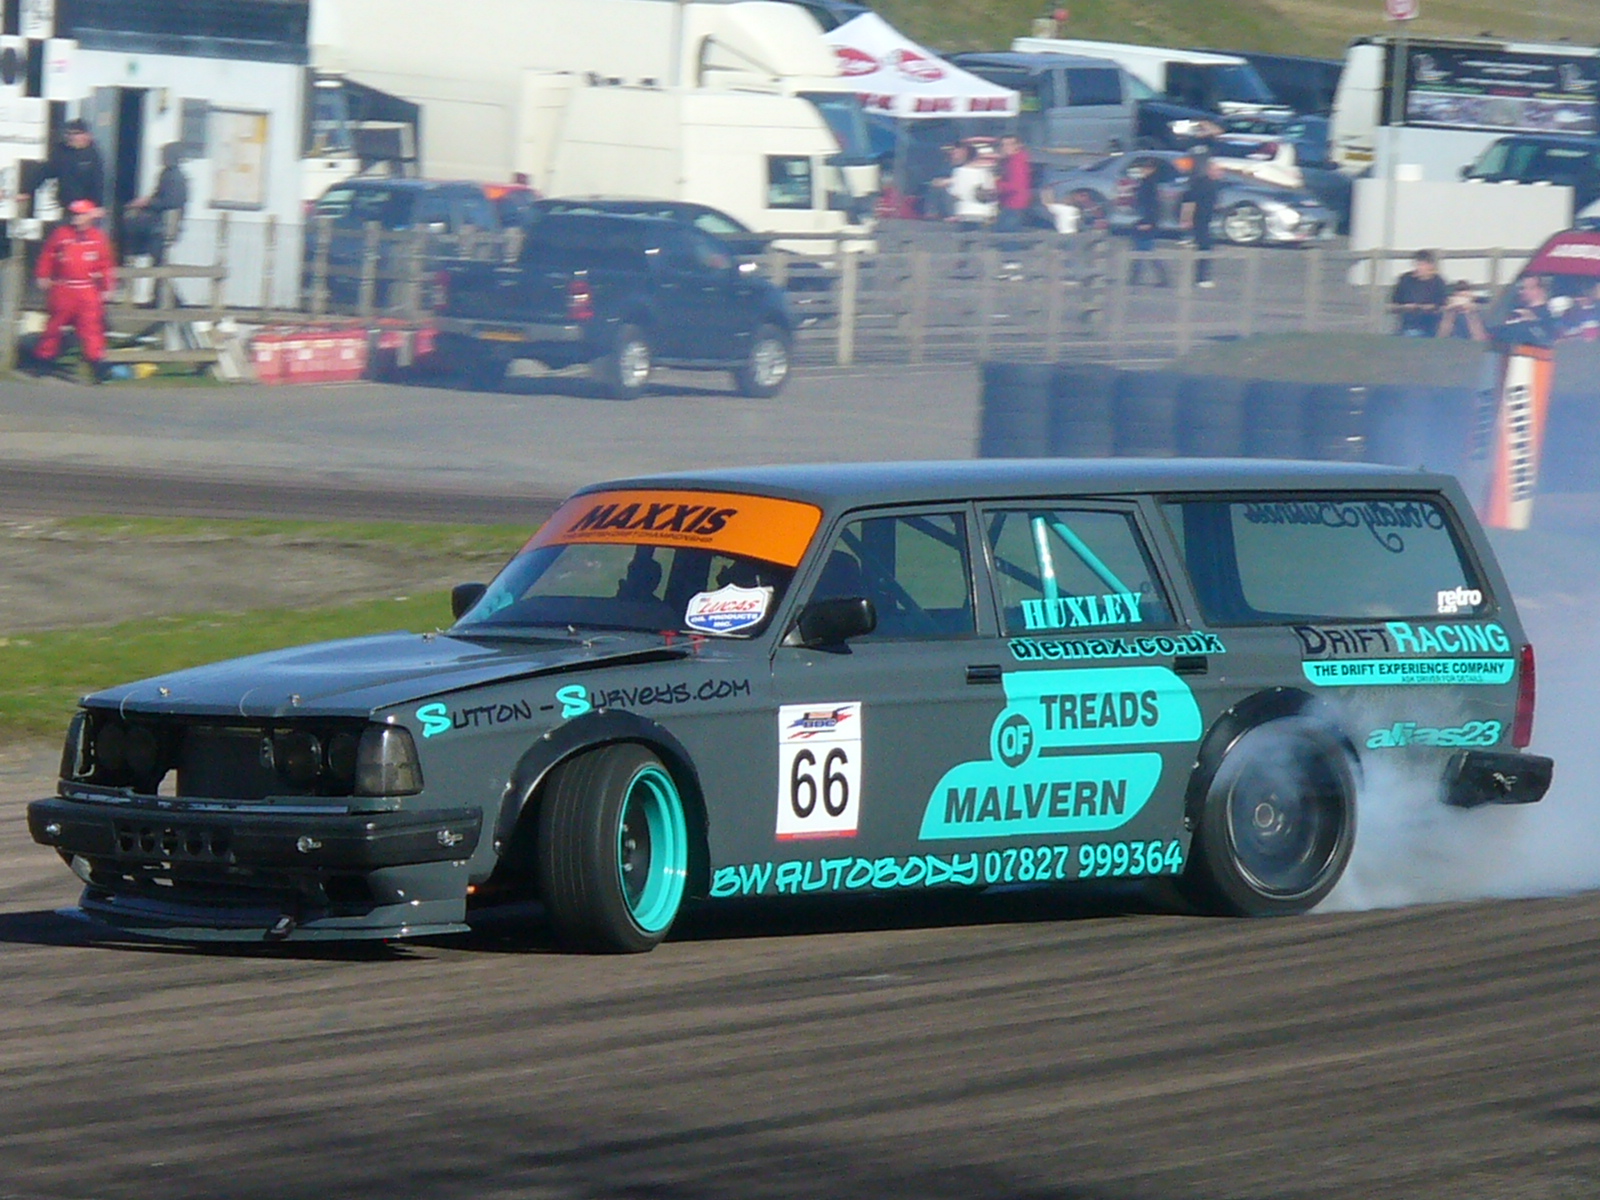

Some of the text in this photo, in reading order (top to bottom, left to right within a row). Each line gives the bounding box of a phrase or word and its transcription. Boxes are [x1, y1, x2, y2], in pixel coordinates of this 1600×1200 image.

[567, 503, 738, 535] MAXXIS
[696, 600, 760, 614] LUCAS
[1020, 591, 1142, 631] HUXLEY
[1437, 585, 1482, 606] retro
[1007, 631, 1227, 660] diemax.co.uk
[1385, 622, 1511, 653] RACING
[1314, 662, 1504, 676] THE DRIFT EXPERIENCE COMPANY
[416, 700, 532, 738] SUTTON
[1039, 690, 1160, 731] TREADS
[1001, 724, 1031, 758] OF
[1366, 719, 1502, 749] alias23
[791, 747, 849, 818] 66
[944, 779, 1127, 824] MALVERN
[709, 839, 1183, 897] BW AUTOBODY 07827 999364
